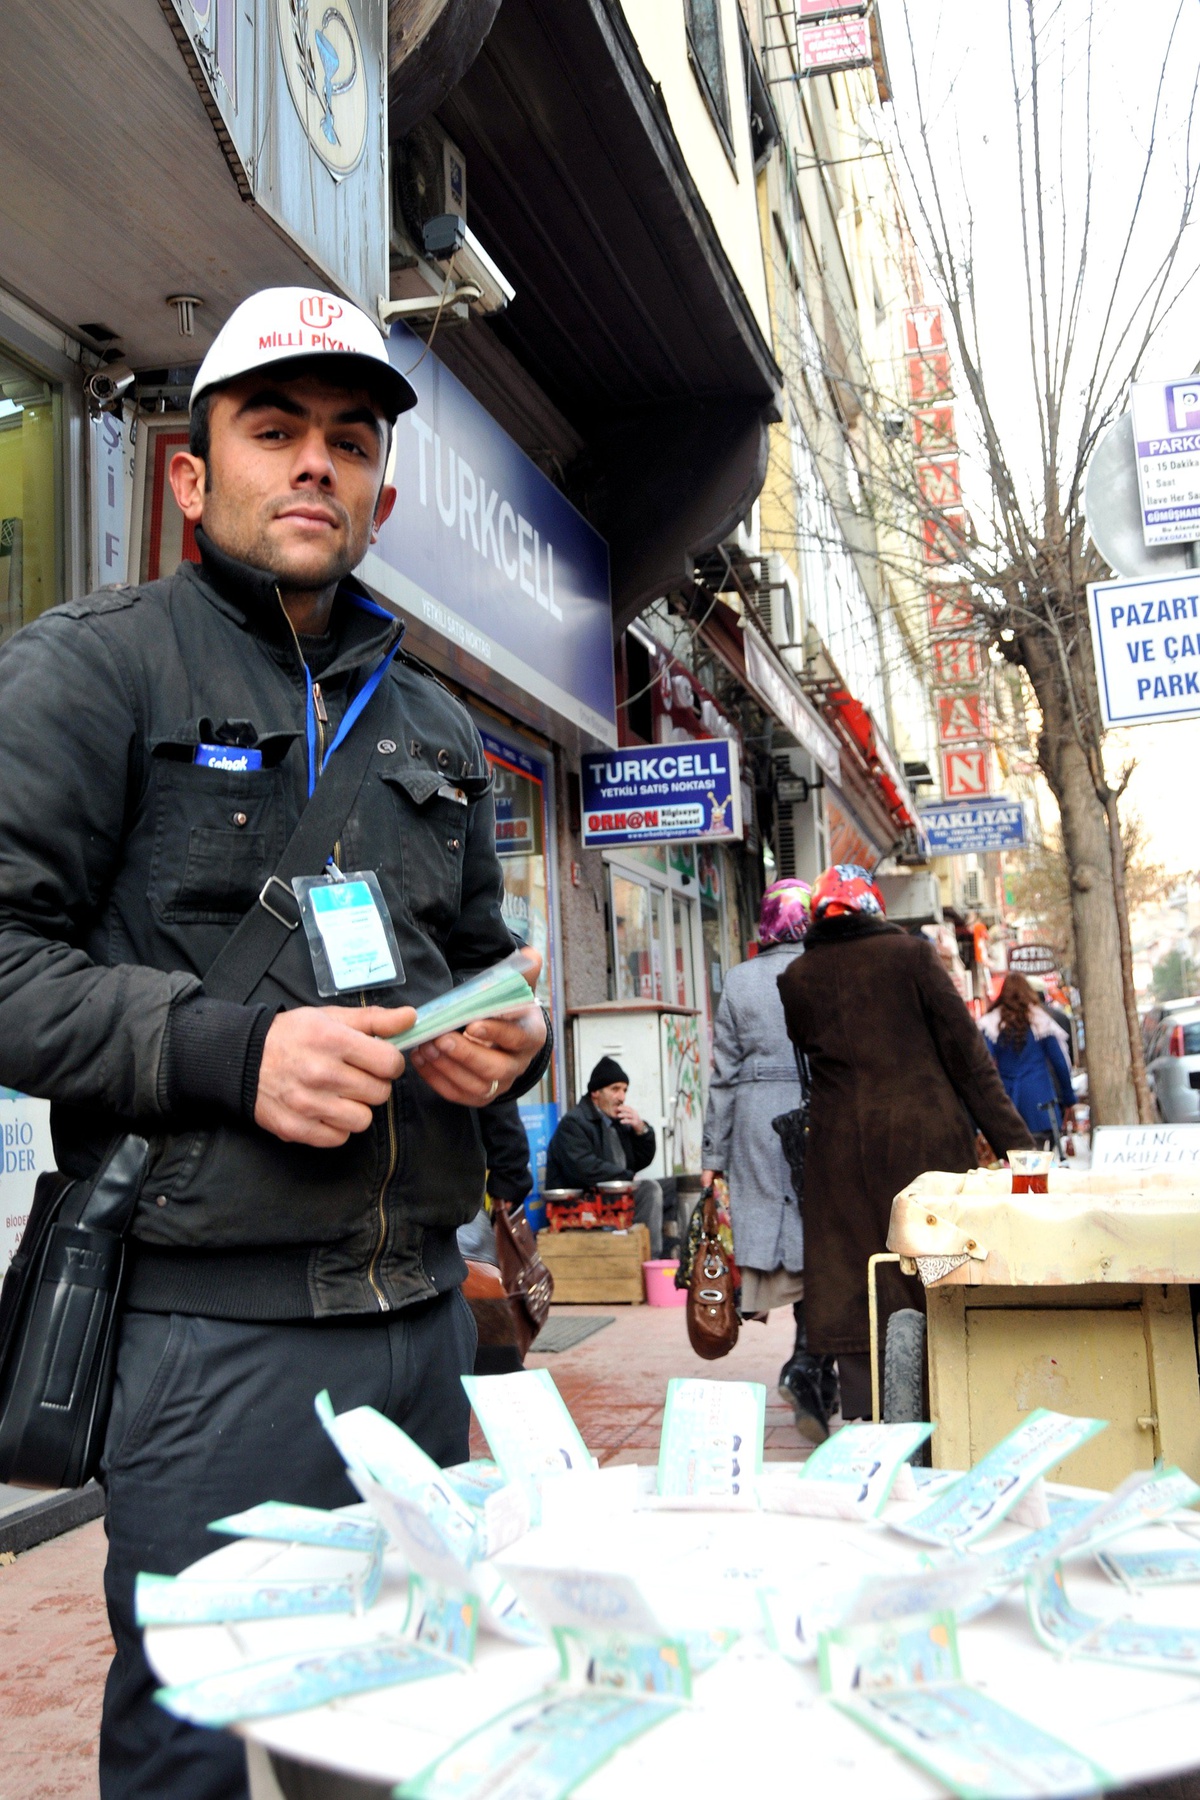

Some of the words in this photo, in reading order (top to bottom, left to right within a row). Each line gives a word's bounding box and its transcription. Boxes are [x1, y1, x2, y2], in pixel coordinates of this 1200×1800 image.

[1157, 461, 1167, 471] 15
[1170, 459, 1200, 470] Dakika
[1156, 478, 1175, 488] Saat
[1170, 493, 1185, 502] Her
[410, 410, 563, 622] TURKCELL
[1126, 639, 1155, 663] VE
[1137, 671, 1200, 700] PARK
[589, 752, 726, 785] TURKCELL
[601, 783, 637, 798] YETKİLİ
[639, 782, 669, 796] SATIŞ
[671, 779, 716, 793] NOKTASI
[5, 1118, 33, 1146] BİO
[5, 1149, 36, 1173] DER
